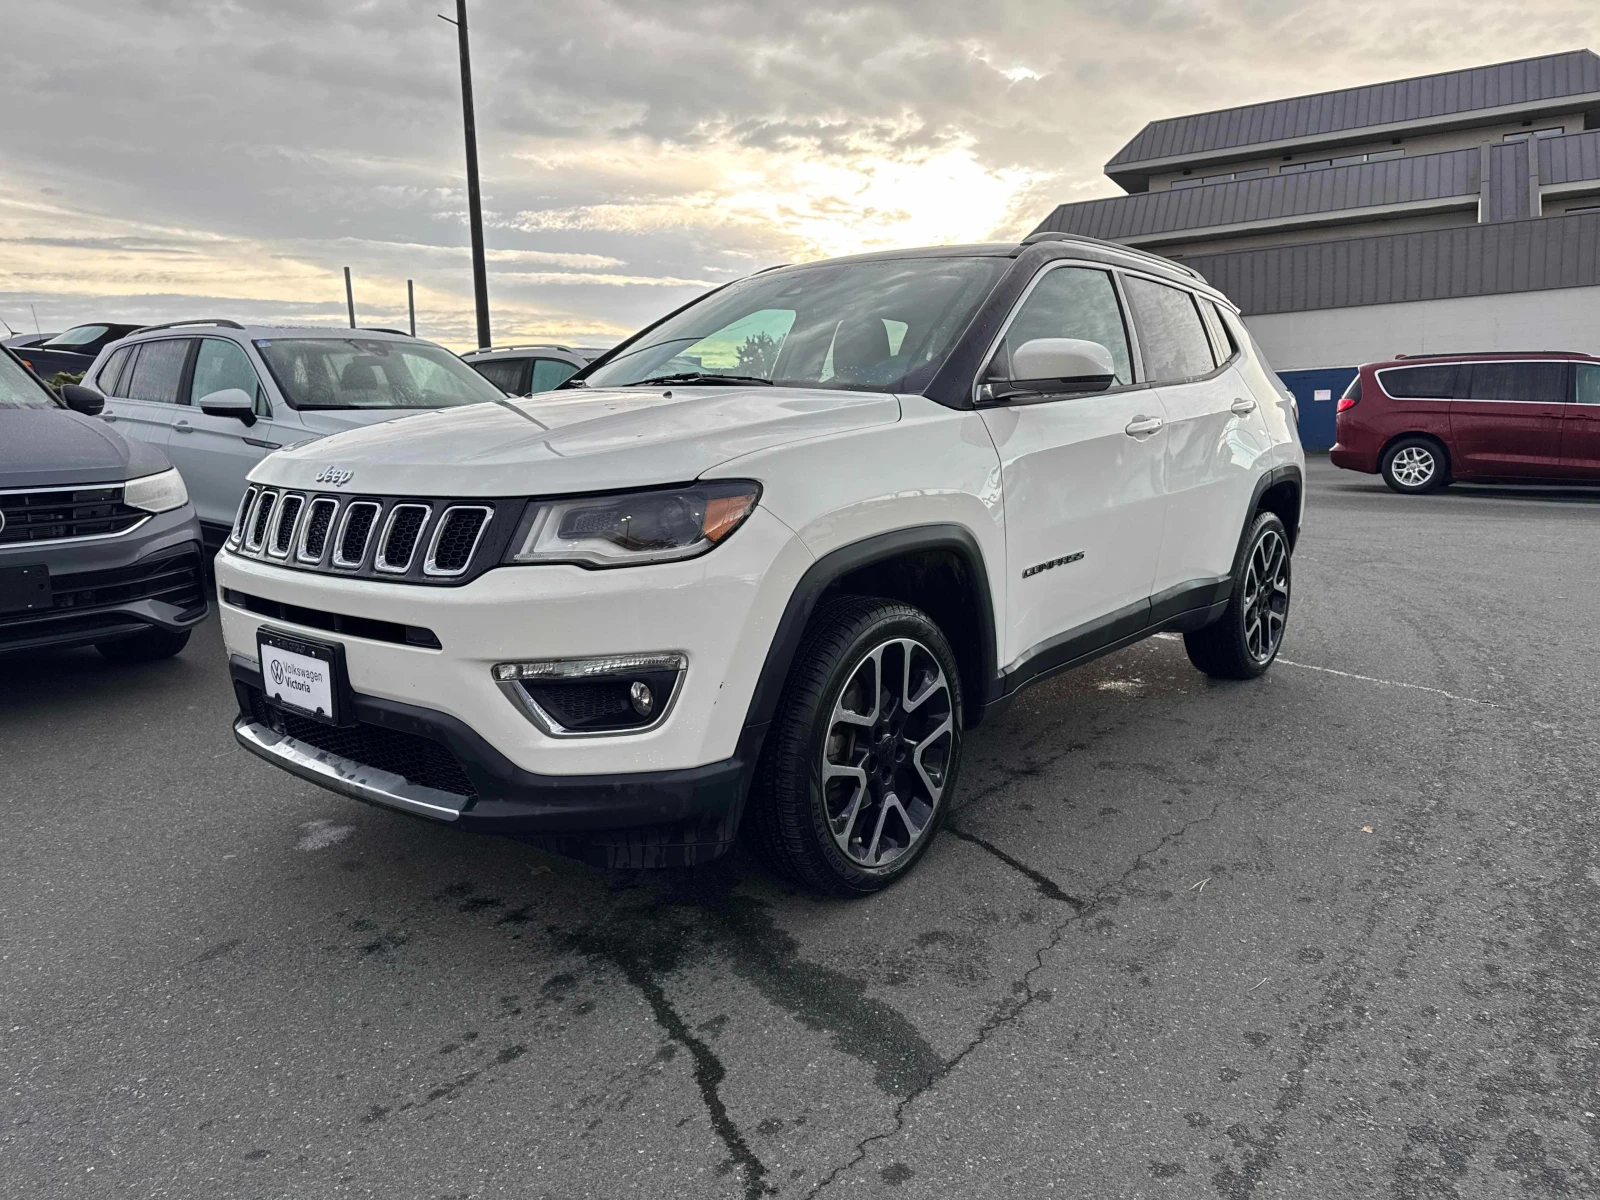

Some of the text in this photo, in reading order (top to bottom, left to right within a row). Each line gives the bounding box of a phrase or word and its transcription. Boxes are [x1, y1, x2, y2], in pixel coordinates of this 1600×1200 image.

[316, 465, 354, 487] Jeep
[1022, 549, 1085, 579] COMPASS
[283, 662, 323, 682] Volkswagen
[285, 676, 310, 693] Victoria
